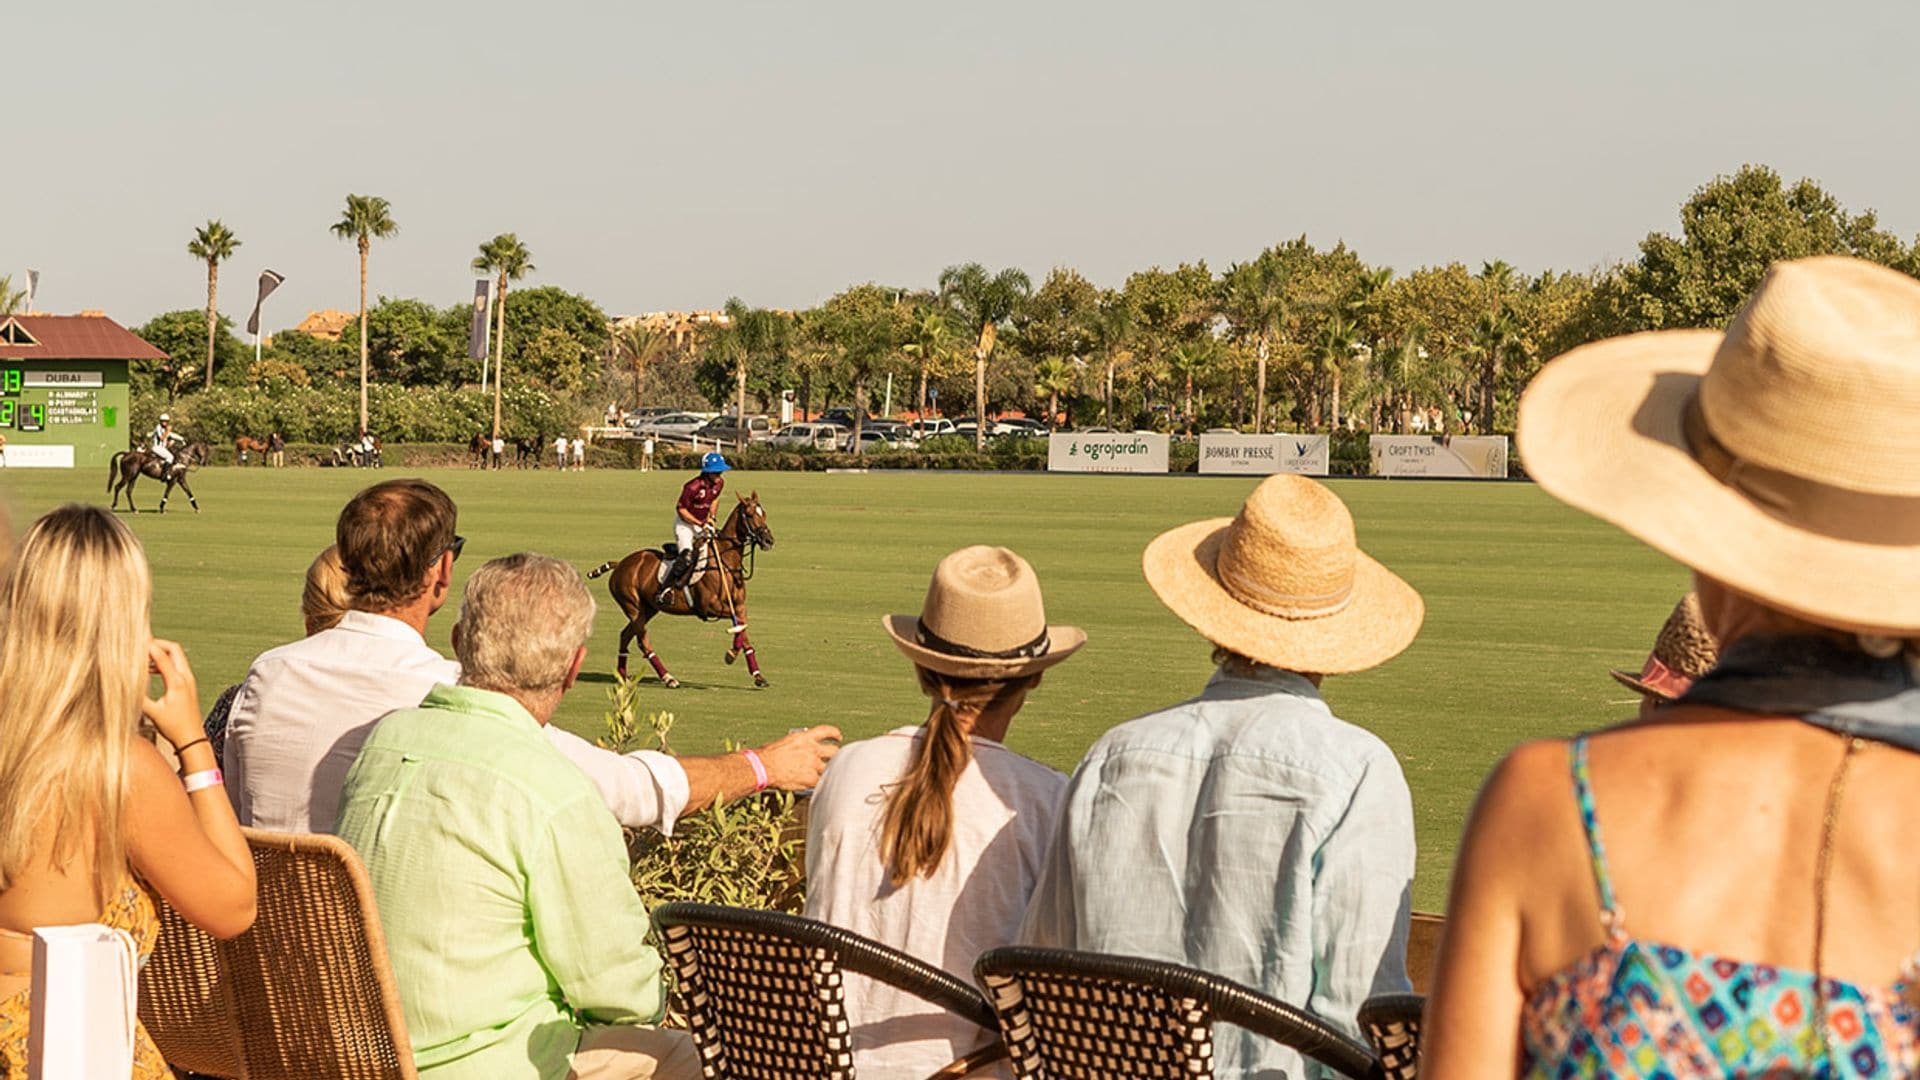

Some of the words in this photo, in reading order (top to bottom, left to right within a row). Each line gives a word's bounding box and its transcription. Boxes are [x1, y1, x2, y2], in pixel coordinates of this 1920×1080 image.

[46, 374, 81, 382] DUBAI
[31, 404, 43, 426] 4
[1204, 447, 1239, 460] BOMBAY
[1388, 444, 1412, 456] CROFT
[1414, 445, 1435, 456] TWIST
